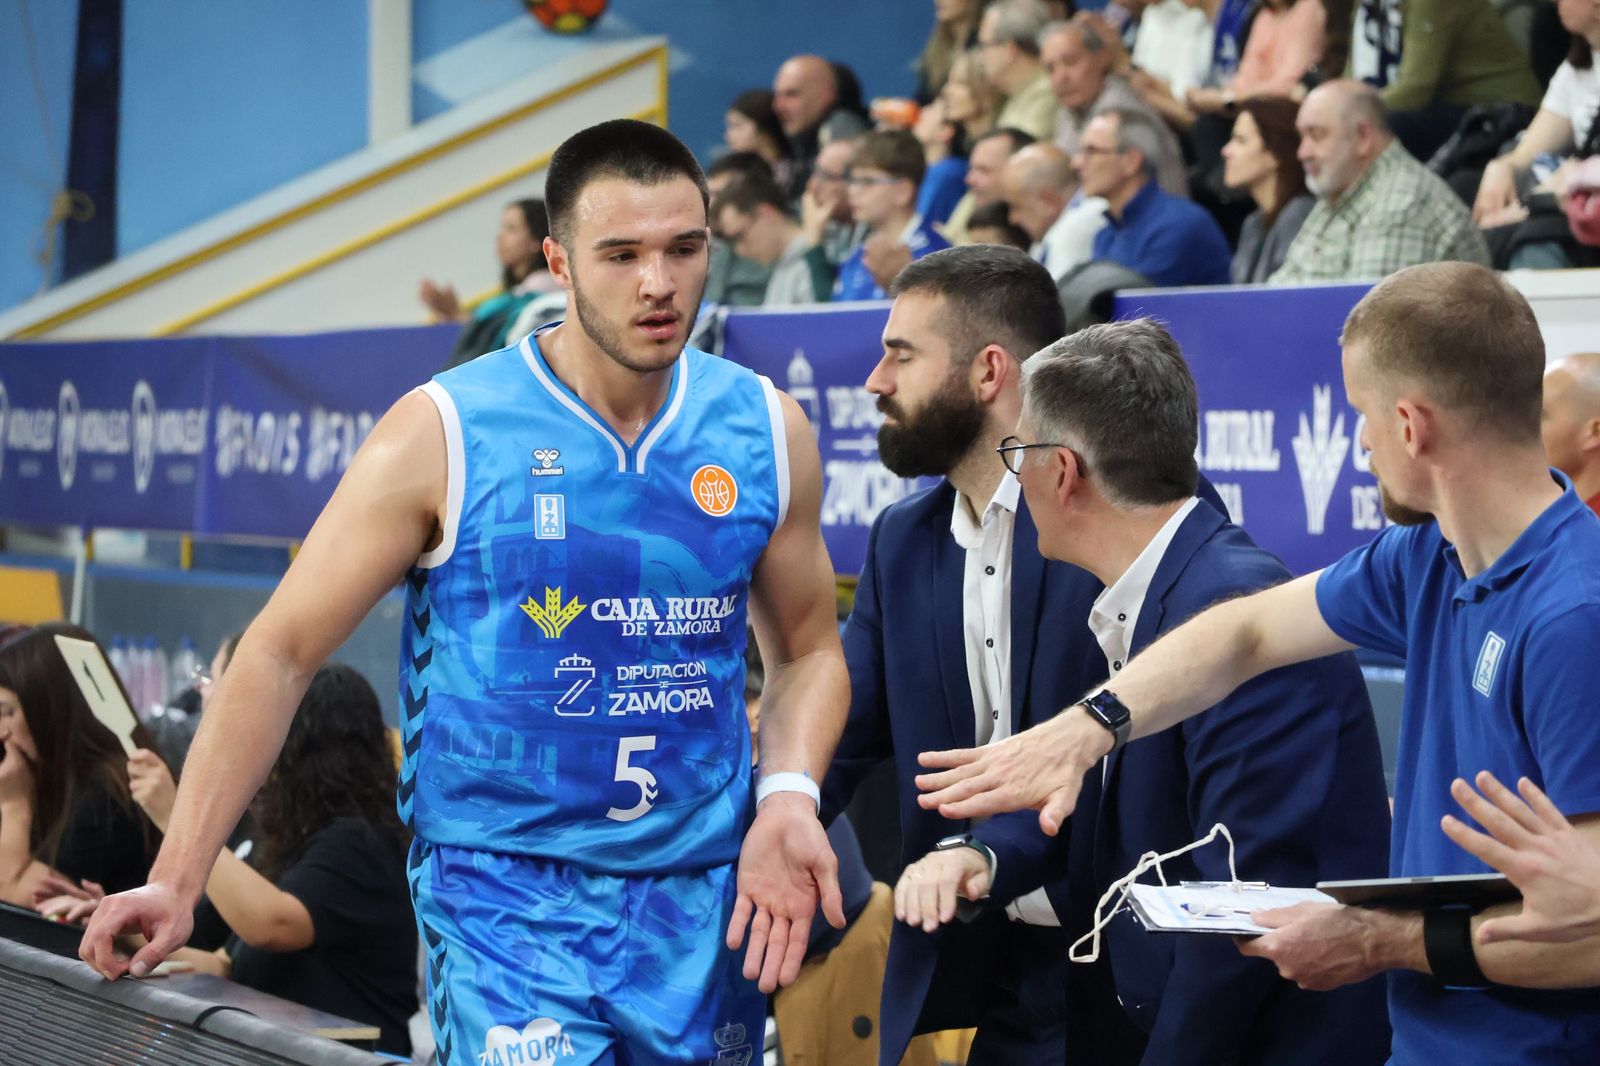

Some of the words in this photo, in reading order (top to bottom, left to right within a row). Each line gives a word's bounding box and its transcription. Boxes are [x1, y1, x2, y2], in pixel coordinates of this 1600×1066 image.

[532, 467, 564, 476] hummel
[591, 597, 659, 621] CAJA
[666, 594, 737, 620] RURAL
[622, 622, 647, 636] DE
[655, 620, 721, 636] ZAMORA
[608, 686, 714, 716] ZAMORA
[606, 735, 658, 822] 5
[478, 1033, 575, 1066] ZAMORA
